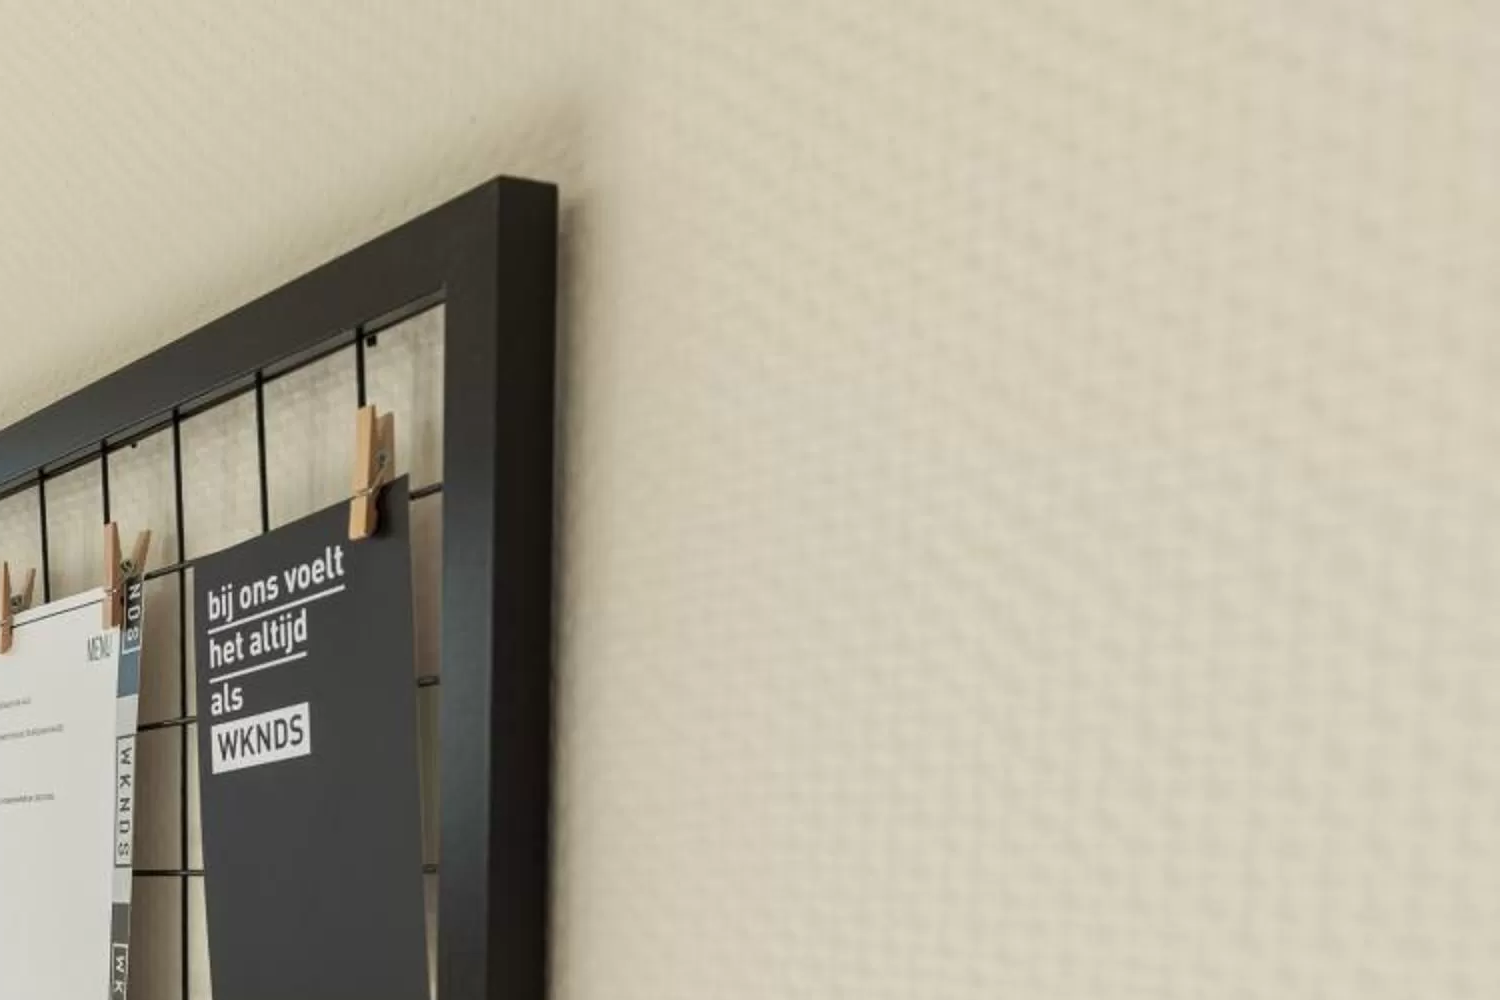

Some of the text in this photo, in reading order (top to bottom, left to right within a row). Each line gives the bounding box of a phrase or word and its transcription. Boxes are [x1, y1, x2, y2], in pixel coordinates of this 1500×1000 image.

[207, 545, 345, 622] bij ons voelt
[208, 608, 308, 669] het altijd
[211, 683, 244, 716] als
[217, 714, 304, 762] WKNDS
[118, 746, 133, 857] WKNDS
